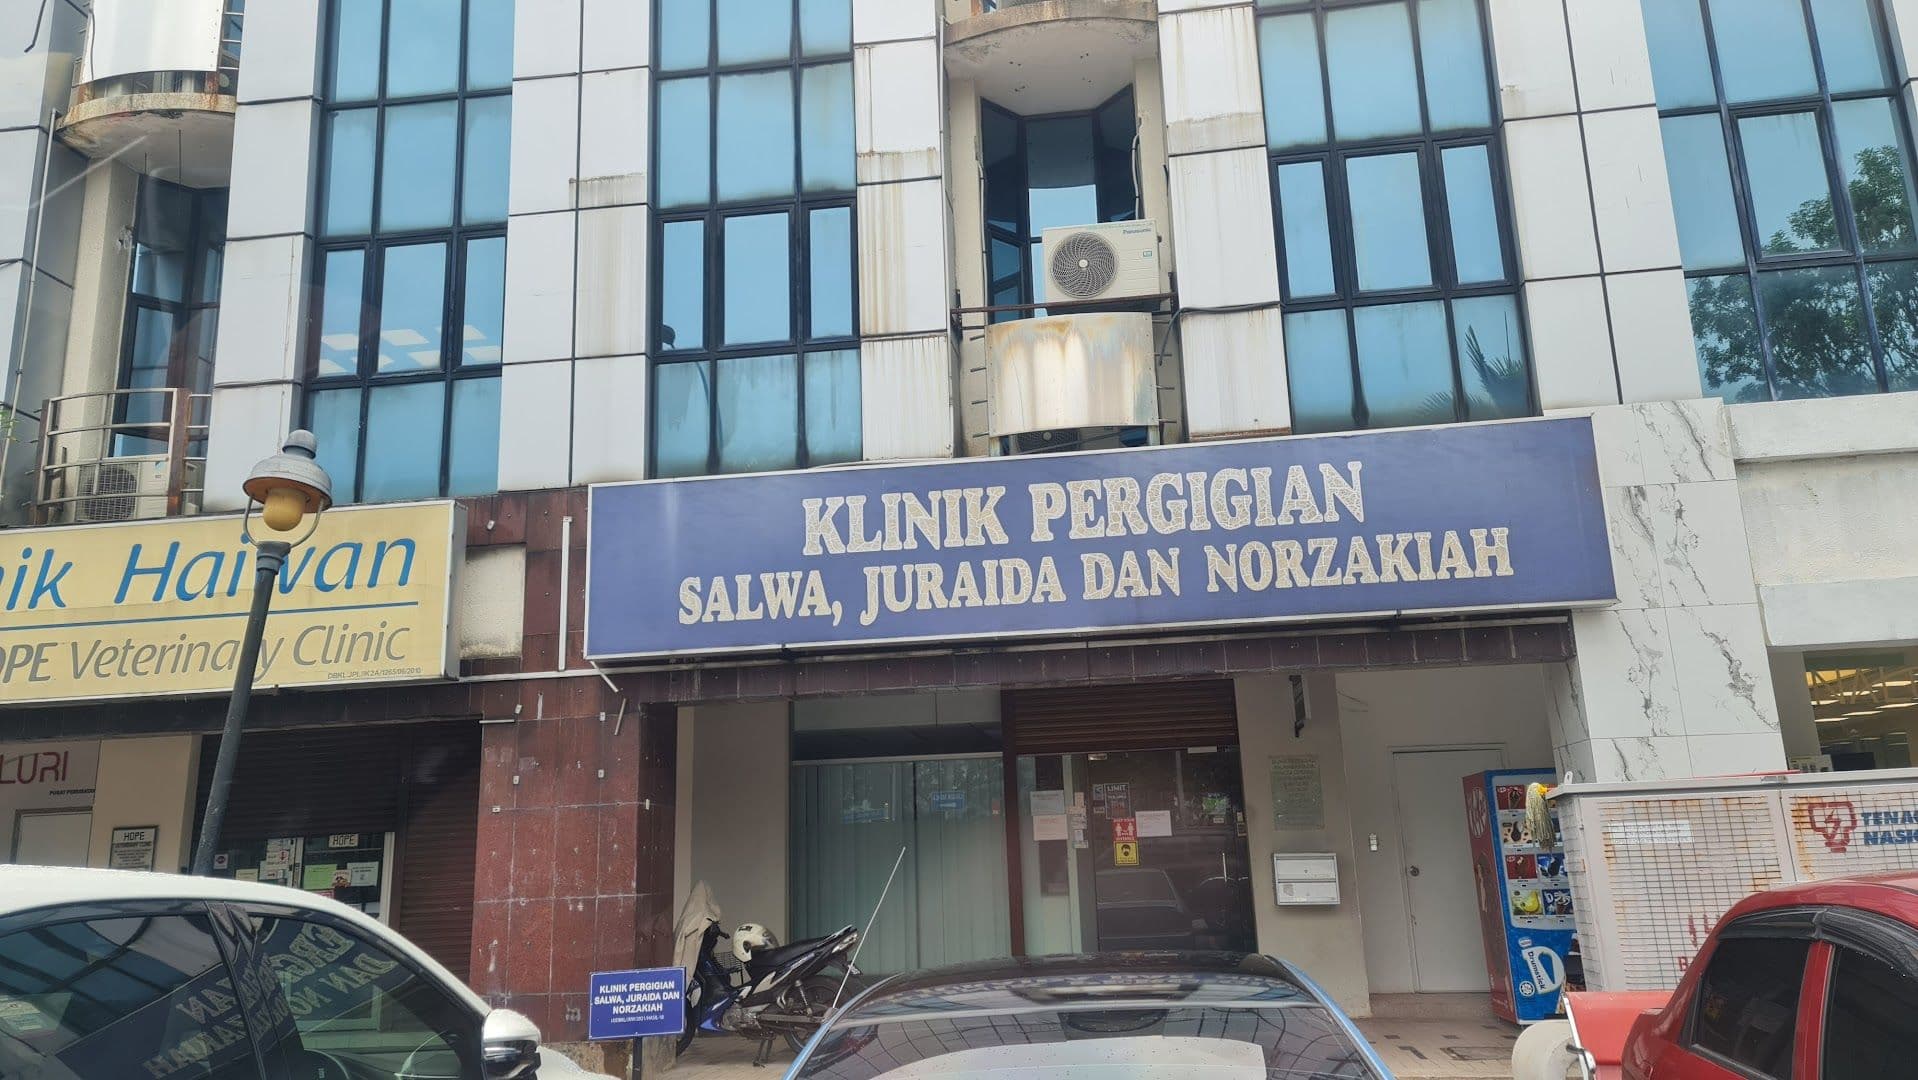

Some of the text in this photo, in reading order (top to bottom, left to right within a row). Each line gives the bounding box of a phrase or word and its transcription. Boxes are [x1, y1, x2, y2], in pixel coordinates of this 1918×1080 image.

[802, 461, 1365, 556] KLINIK PERGIGIAN
[0, 547, 73, 611] ik
[679, 527, 1514, 626] SALWA, JURAIDA DAN NORZAKIAH
[0, 620, 411, 684] PE Veterinay Clinic
[124, 831, 145, 841] HOPE
[332, 834, 356, 846] HOPE
[1527, 951, 1546, 990] Drumstick
[594, 991, 680, 1005] SALWA, JURAIDA DAN
[599, 981, 675, 994] KLINIK PERGIGIAN
[612, 1003, 663, 1015] NORZAKIAH
